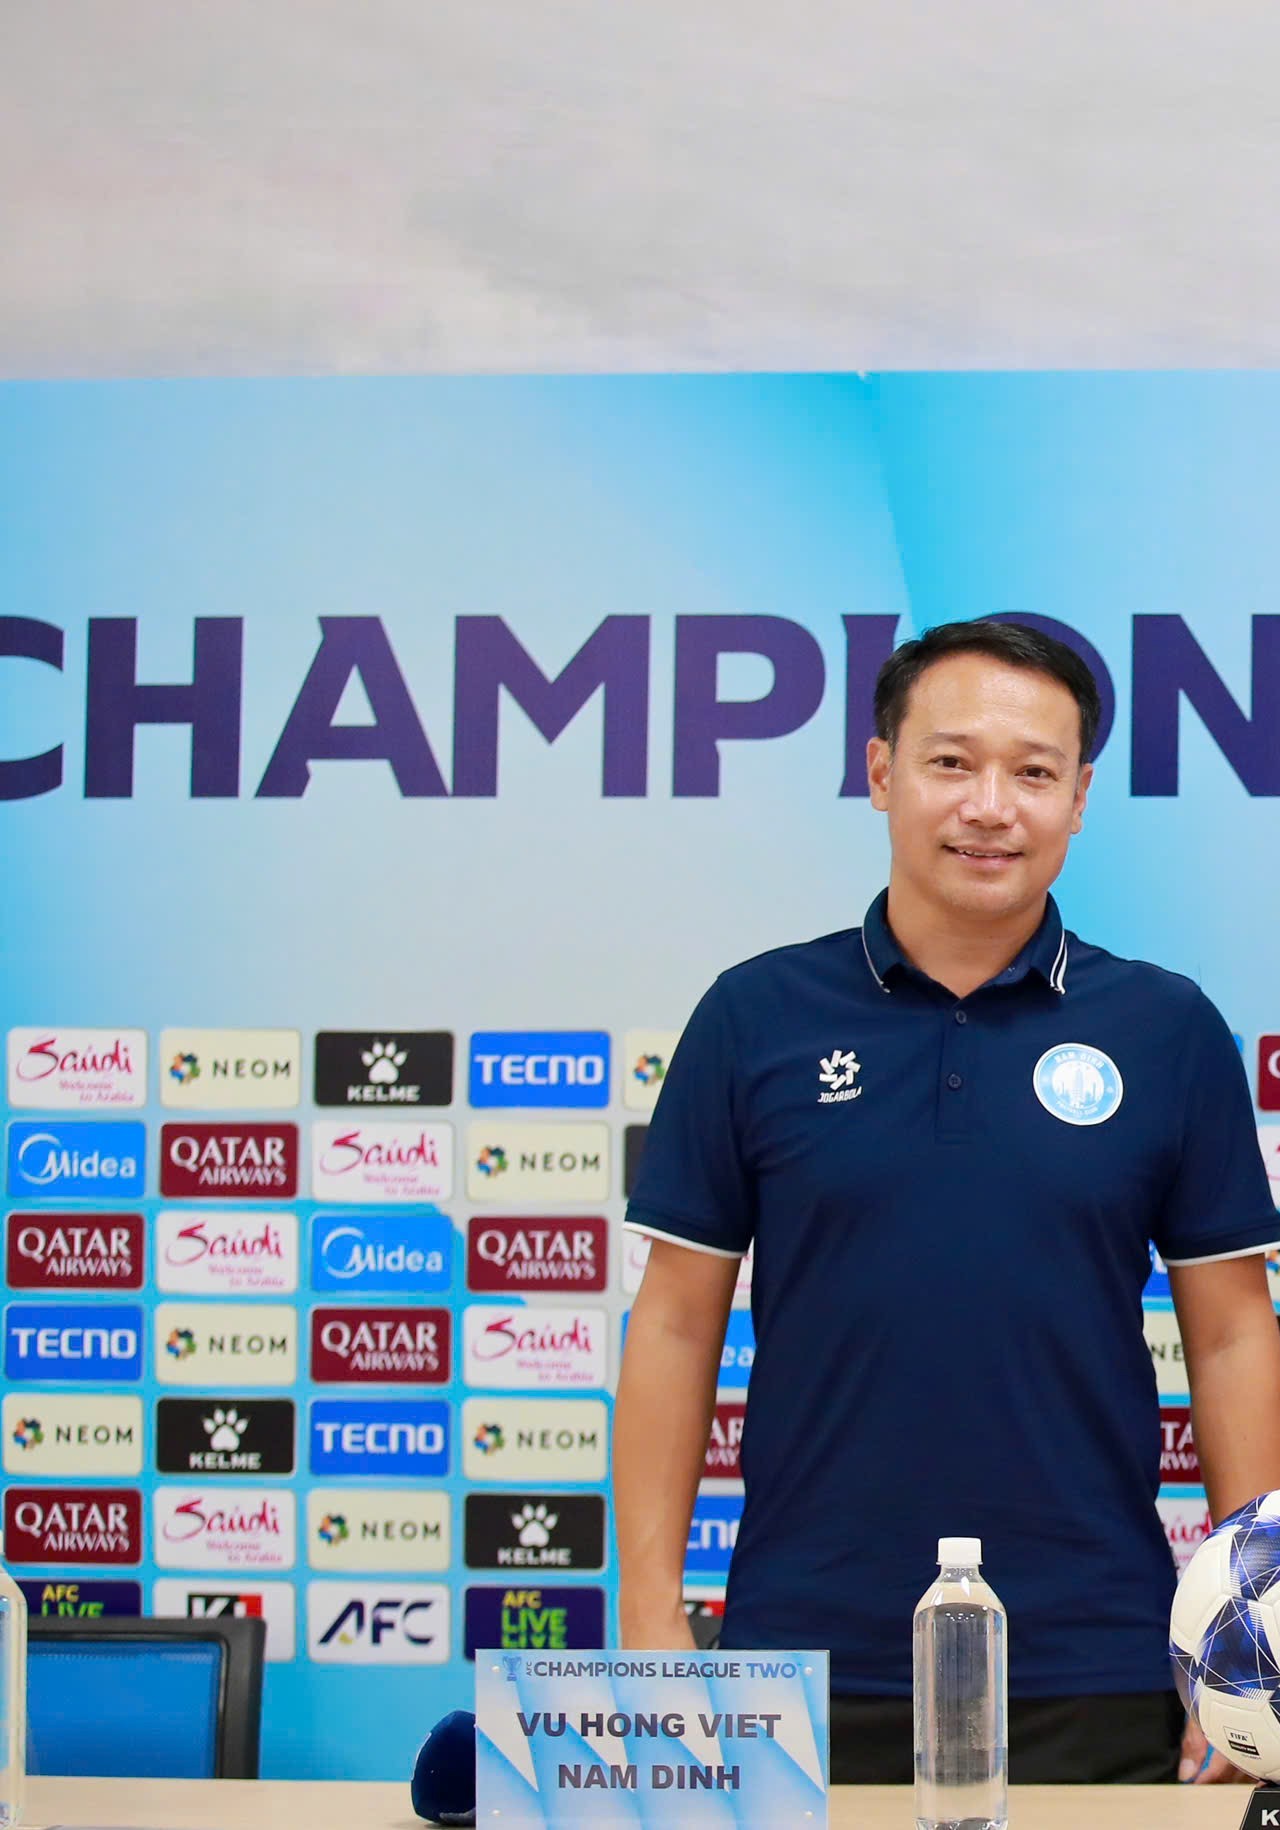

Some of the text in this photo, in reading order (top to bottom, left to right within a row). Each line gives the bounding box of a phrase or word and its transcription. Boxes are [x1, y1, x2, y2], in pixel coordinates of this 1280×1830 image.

[212, 1059, 291, 1079] NEOM
[474, 1055, 604, 1085] TECNO
[347, 1085, 420, 1101] KELME
[170, 1136, 285, 1172] QATAR
[520, 1152, 600, 1171] NEOM
[199, 1166, 286, 1186] AIRWAYS
[17, 1227, 131, 1263] QATAR
[477, 1230, 594, 1266] QATAR
[46, 1257, 131, 1276] AIRWAYS
[507, 1261, 595, 1280] AIRWAYS
[11, 1328, 136, 1359] TECNO
[209, 1336, 287, 1355] NEOM
[321, 1321, 438, 1357] QATAR
[351, 1352, 439, 1371] AIRWAYS
[56, 1426, 133, 1444] NEOM
[314, 1423, 445, 1454] TECNO
[517, 1431, 597, 1449] NEOM
[189, 1453, 261, 1469] KELME
[15, 1502, 128, 1537] QATAR
[361, 1521, 441, 1540] NEOM
[44, 1532, 129, 1552] AIRWAYS
[497, 1548, 571, 1565] KELME
[42, 1584, 79, 1602] AFC
[503, 1590, 541, 1609] AFC
[319, 1599, 434, 1645] AFC
[502, 1608, 567, 1632] LIVE
[533, 1661, 656, 1678] CHAMPIONS
[662, 1662, 741, 1678] LEAGUE
[746, 1663, 798, 1678] TWO
[516, 1712, 782, 1738] VU HONG VIET
[558, 1764, 741, 1790] NAM DINH
